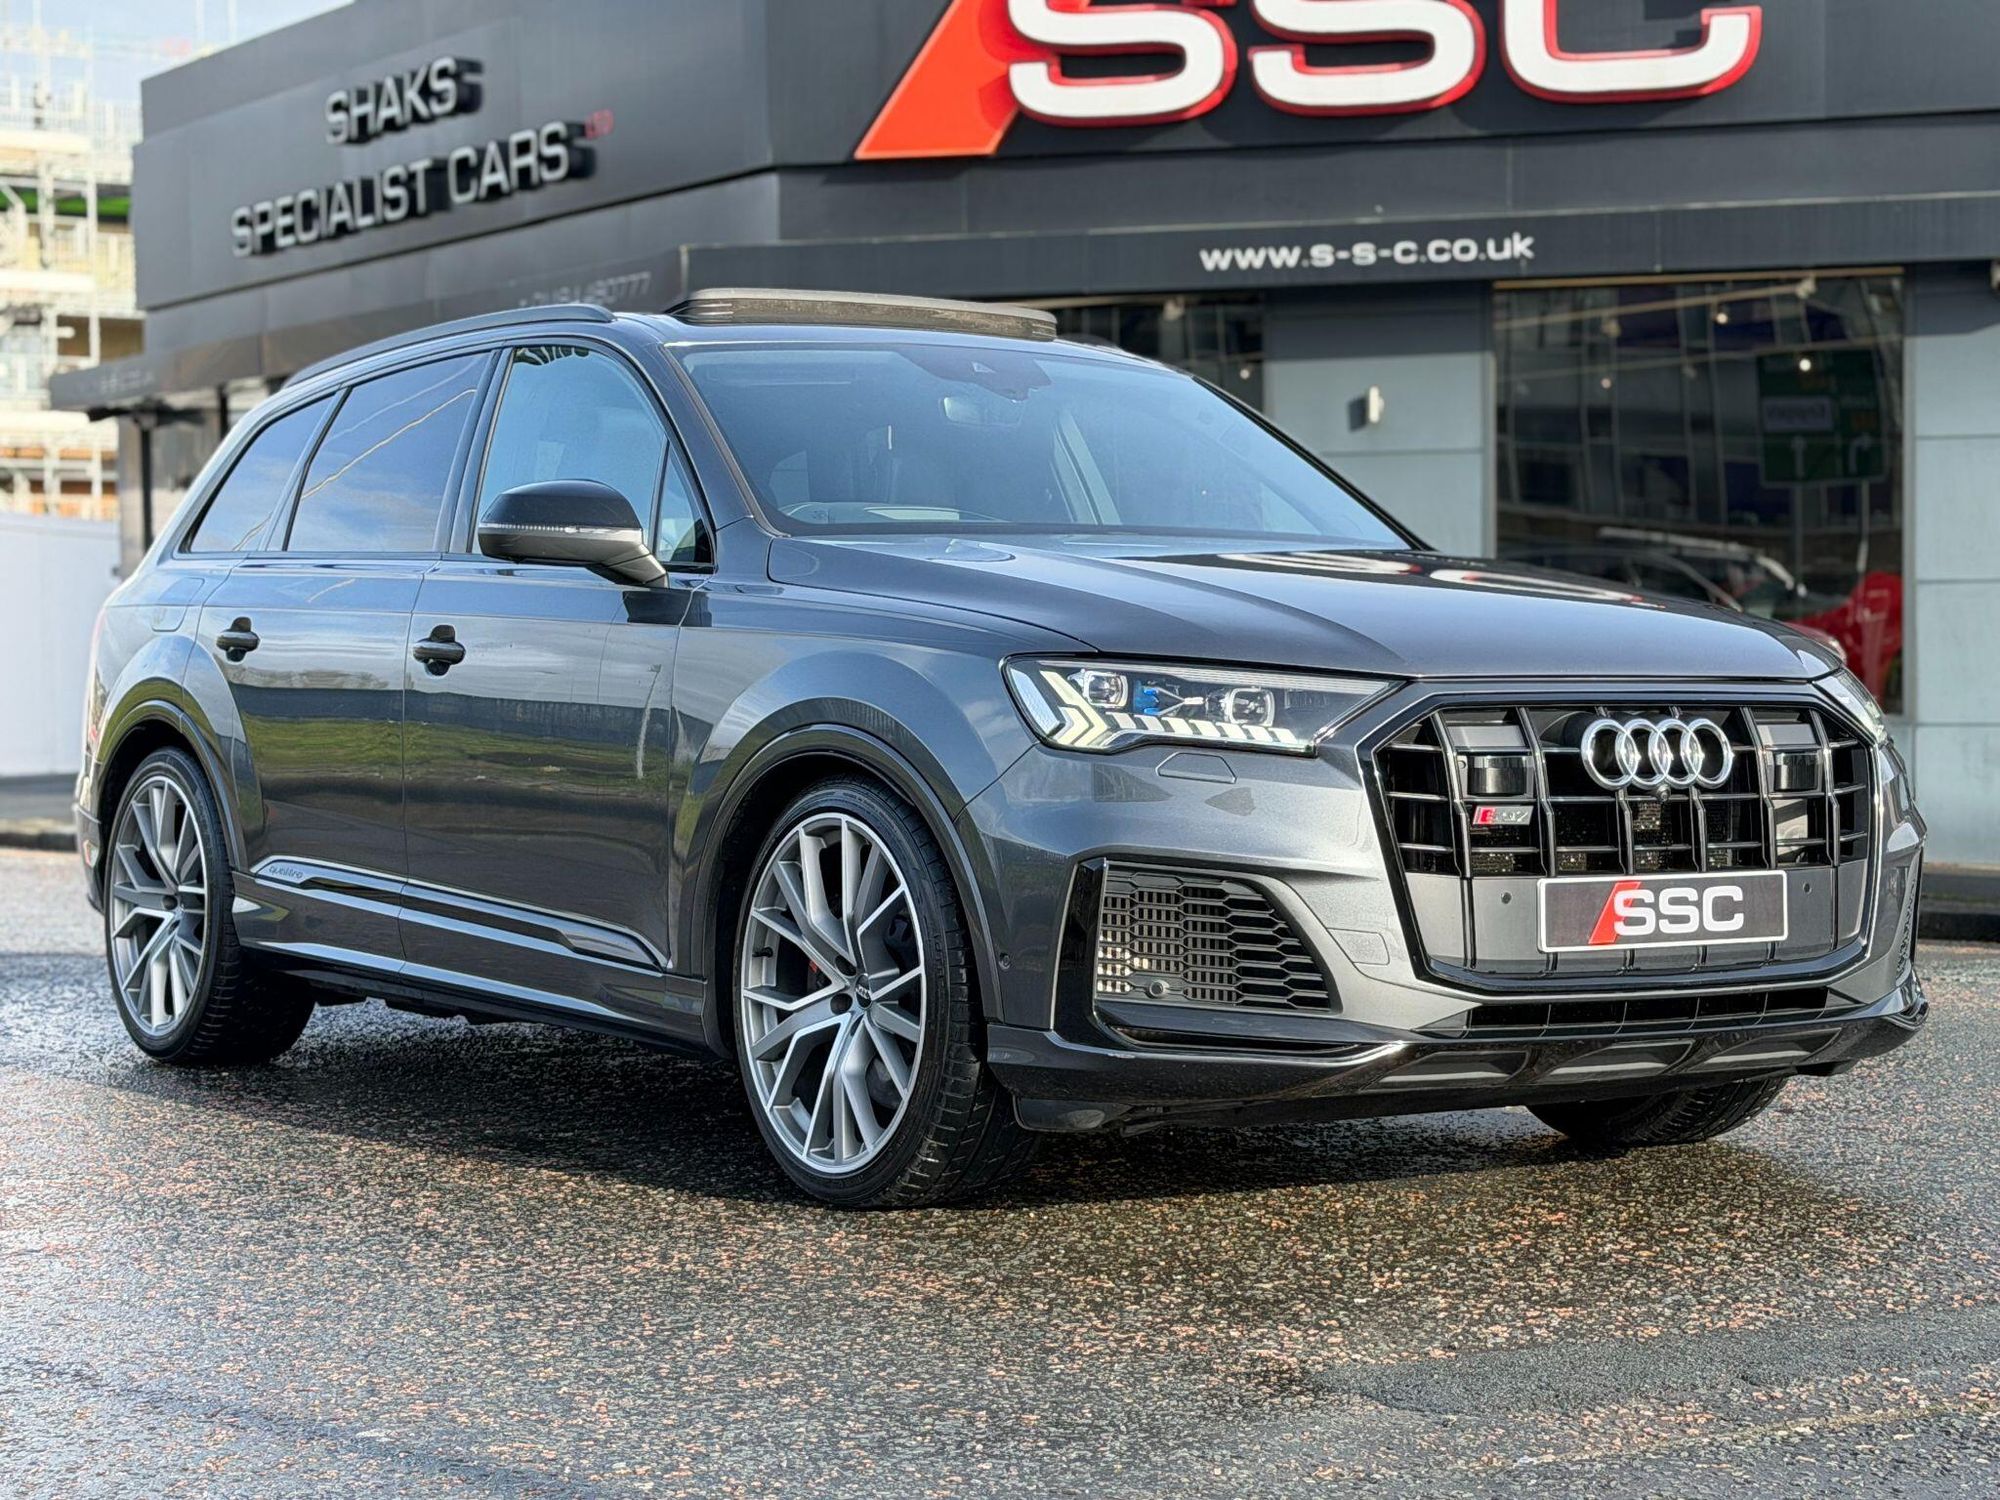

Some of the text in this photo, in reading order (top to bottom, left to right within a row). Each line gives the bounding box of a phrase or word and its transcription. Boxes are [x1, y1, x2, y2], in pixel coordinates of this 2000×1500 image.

[324, 55, 457, 145] SHAKS
[230, 157, 433, 258] SPECIALIST
[449, 120, 569, 205] CARS
[1200, 231, 1536, 271] www.s-s-c.co.uk
[1613, 885, 1744, 936] SSC
